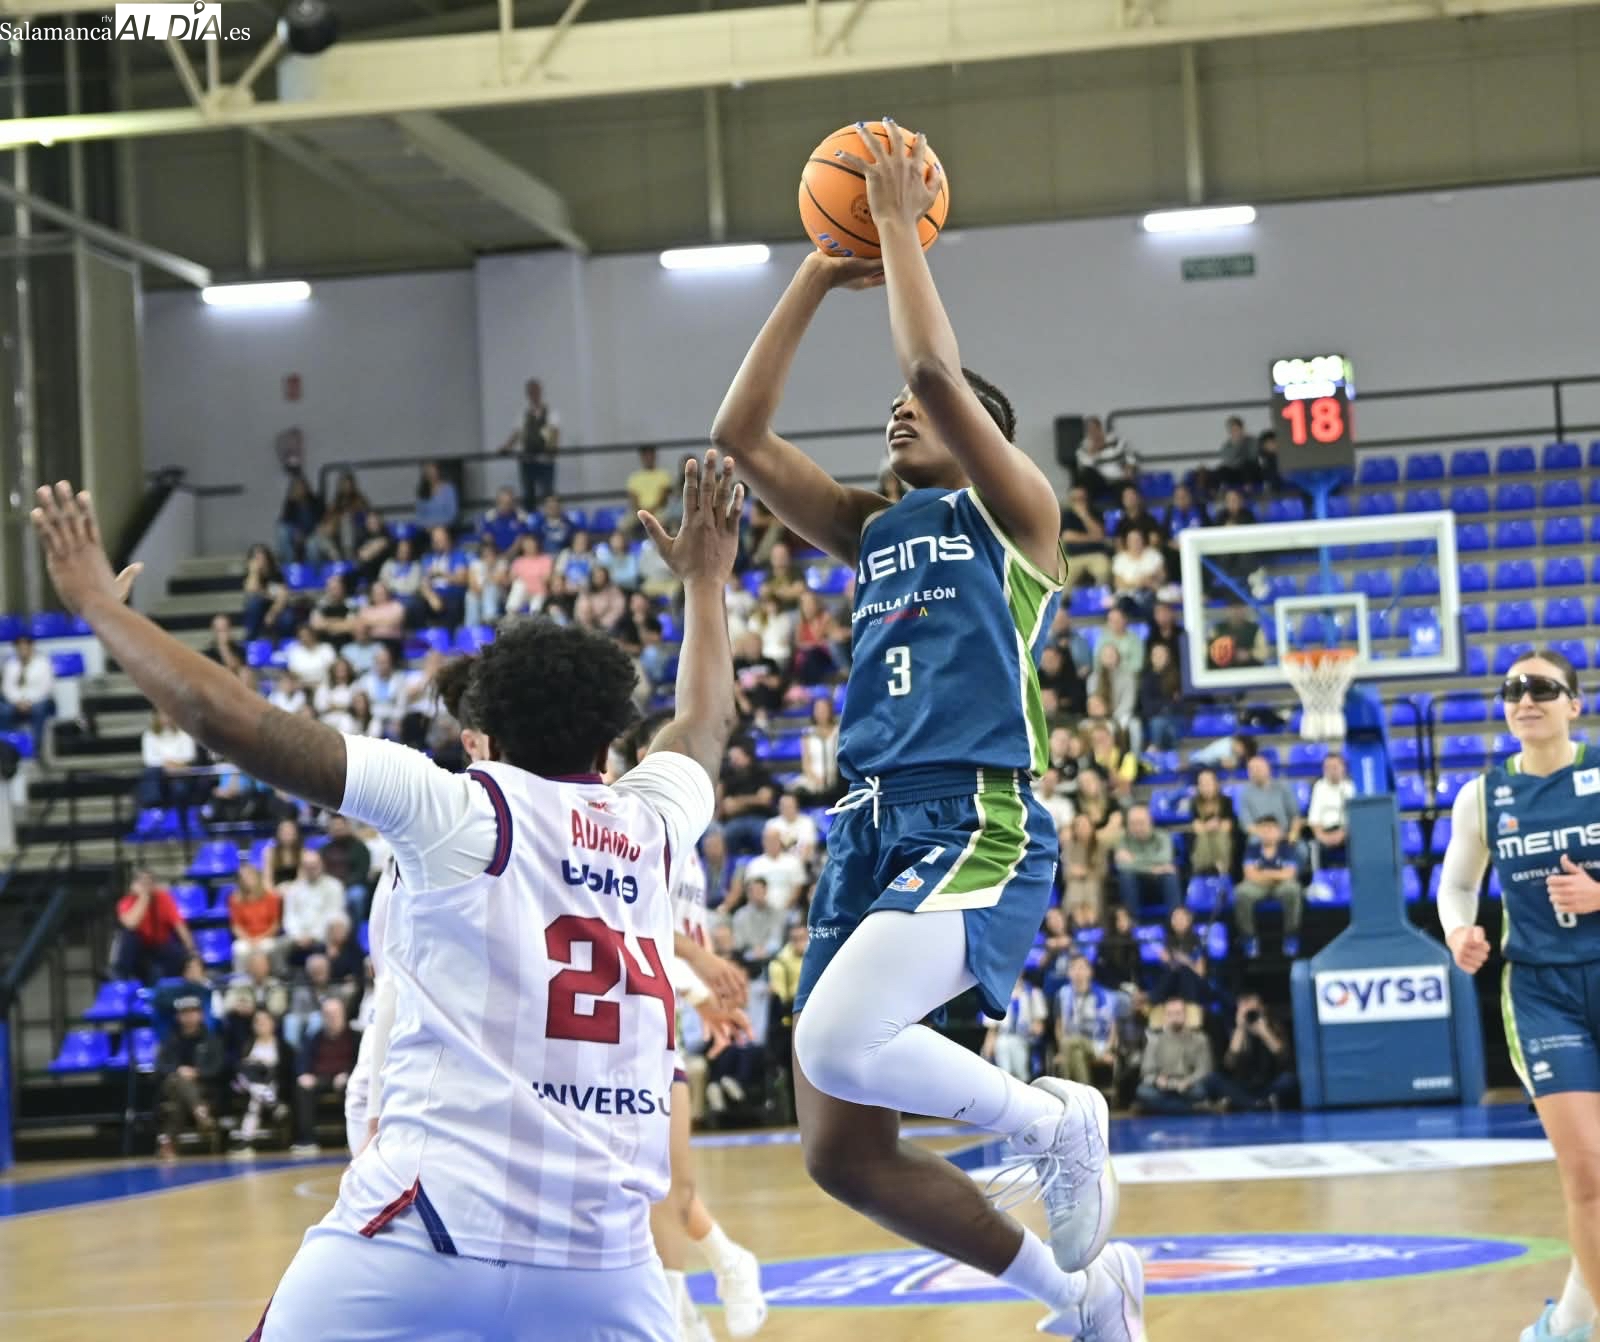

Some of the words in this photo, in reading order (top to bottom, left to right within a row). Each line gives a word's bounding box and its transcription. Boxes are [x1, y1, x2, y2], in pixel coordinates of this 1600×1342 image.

[1282, 396, 1344, 445] 18
[858, 534, 975, 584] EINS
[913, 586, 956, 602] LEÓN
[885, 646, 911, 696] 3
[1496, 822, 1600, 860] MEINS
[545, 914, 675, 1050] 24
